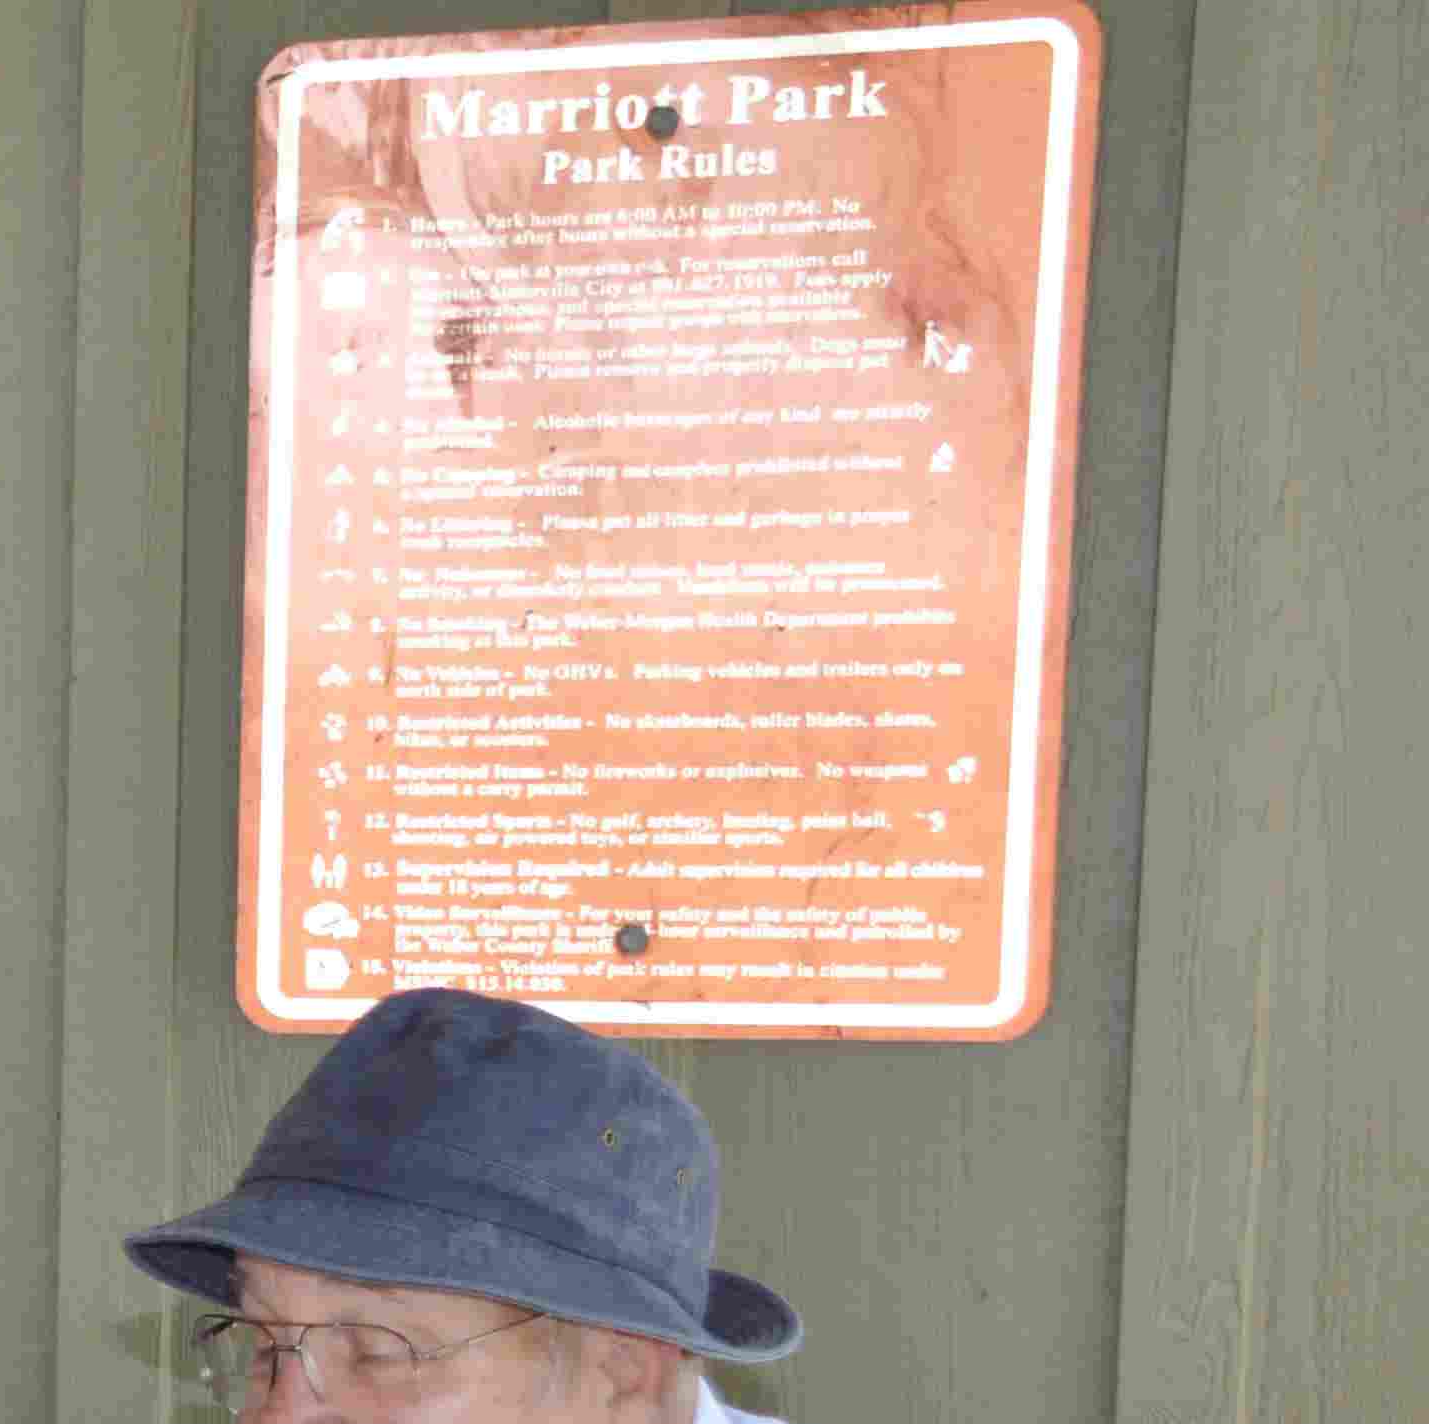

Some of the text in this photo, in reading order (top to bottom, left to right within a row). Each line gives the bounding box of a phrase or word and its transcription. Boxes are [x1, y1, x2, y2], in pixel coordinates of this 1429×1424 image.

[422, 70, 887, 140] Marriott Park
[541, 141, 778, 185] Park Rules
[486, 212, 525, 230] Park
[530, 210, 583, 228] hours
[661, 206, 697, 222] AM
[832, 199, 861, 215] No
[559, 226, 608, 243] hours
[681, 255, 713, 273] For
[830, 248, 868, 267] call
[586, 279, 624, 299] City
[763, 609, 869, 629] Department
[523, 663, 549, 680] No
[784, 661, 817, 678] and
[605, 713, 630, 729] No
[562, 764, 588, 780] No
[816, 763, 844, 780] No
[569, 812, 598, 829] No
[612, 905, 652, 923] your
